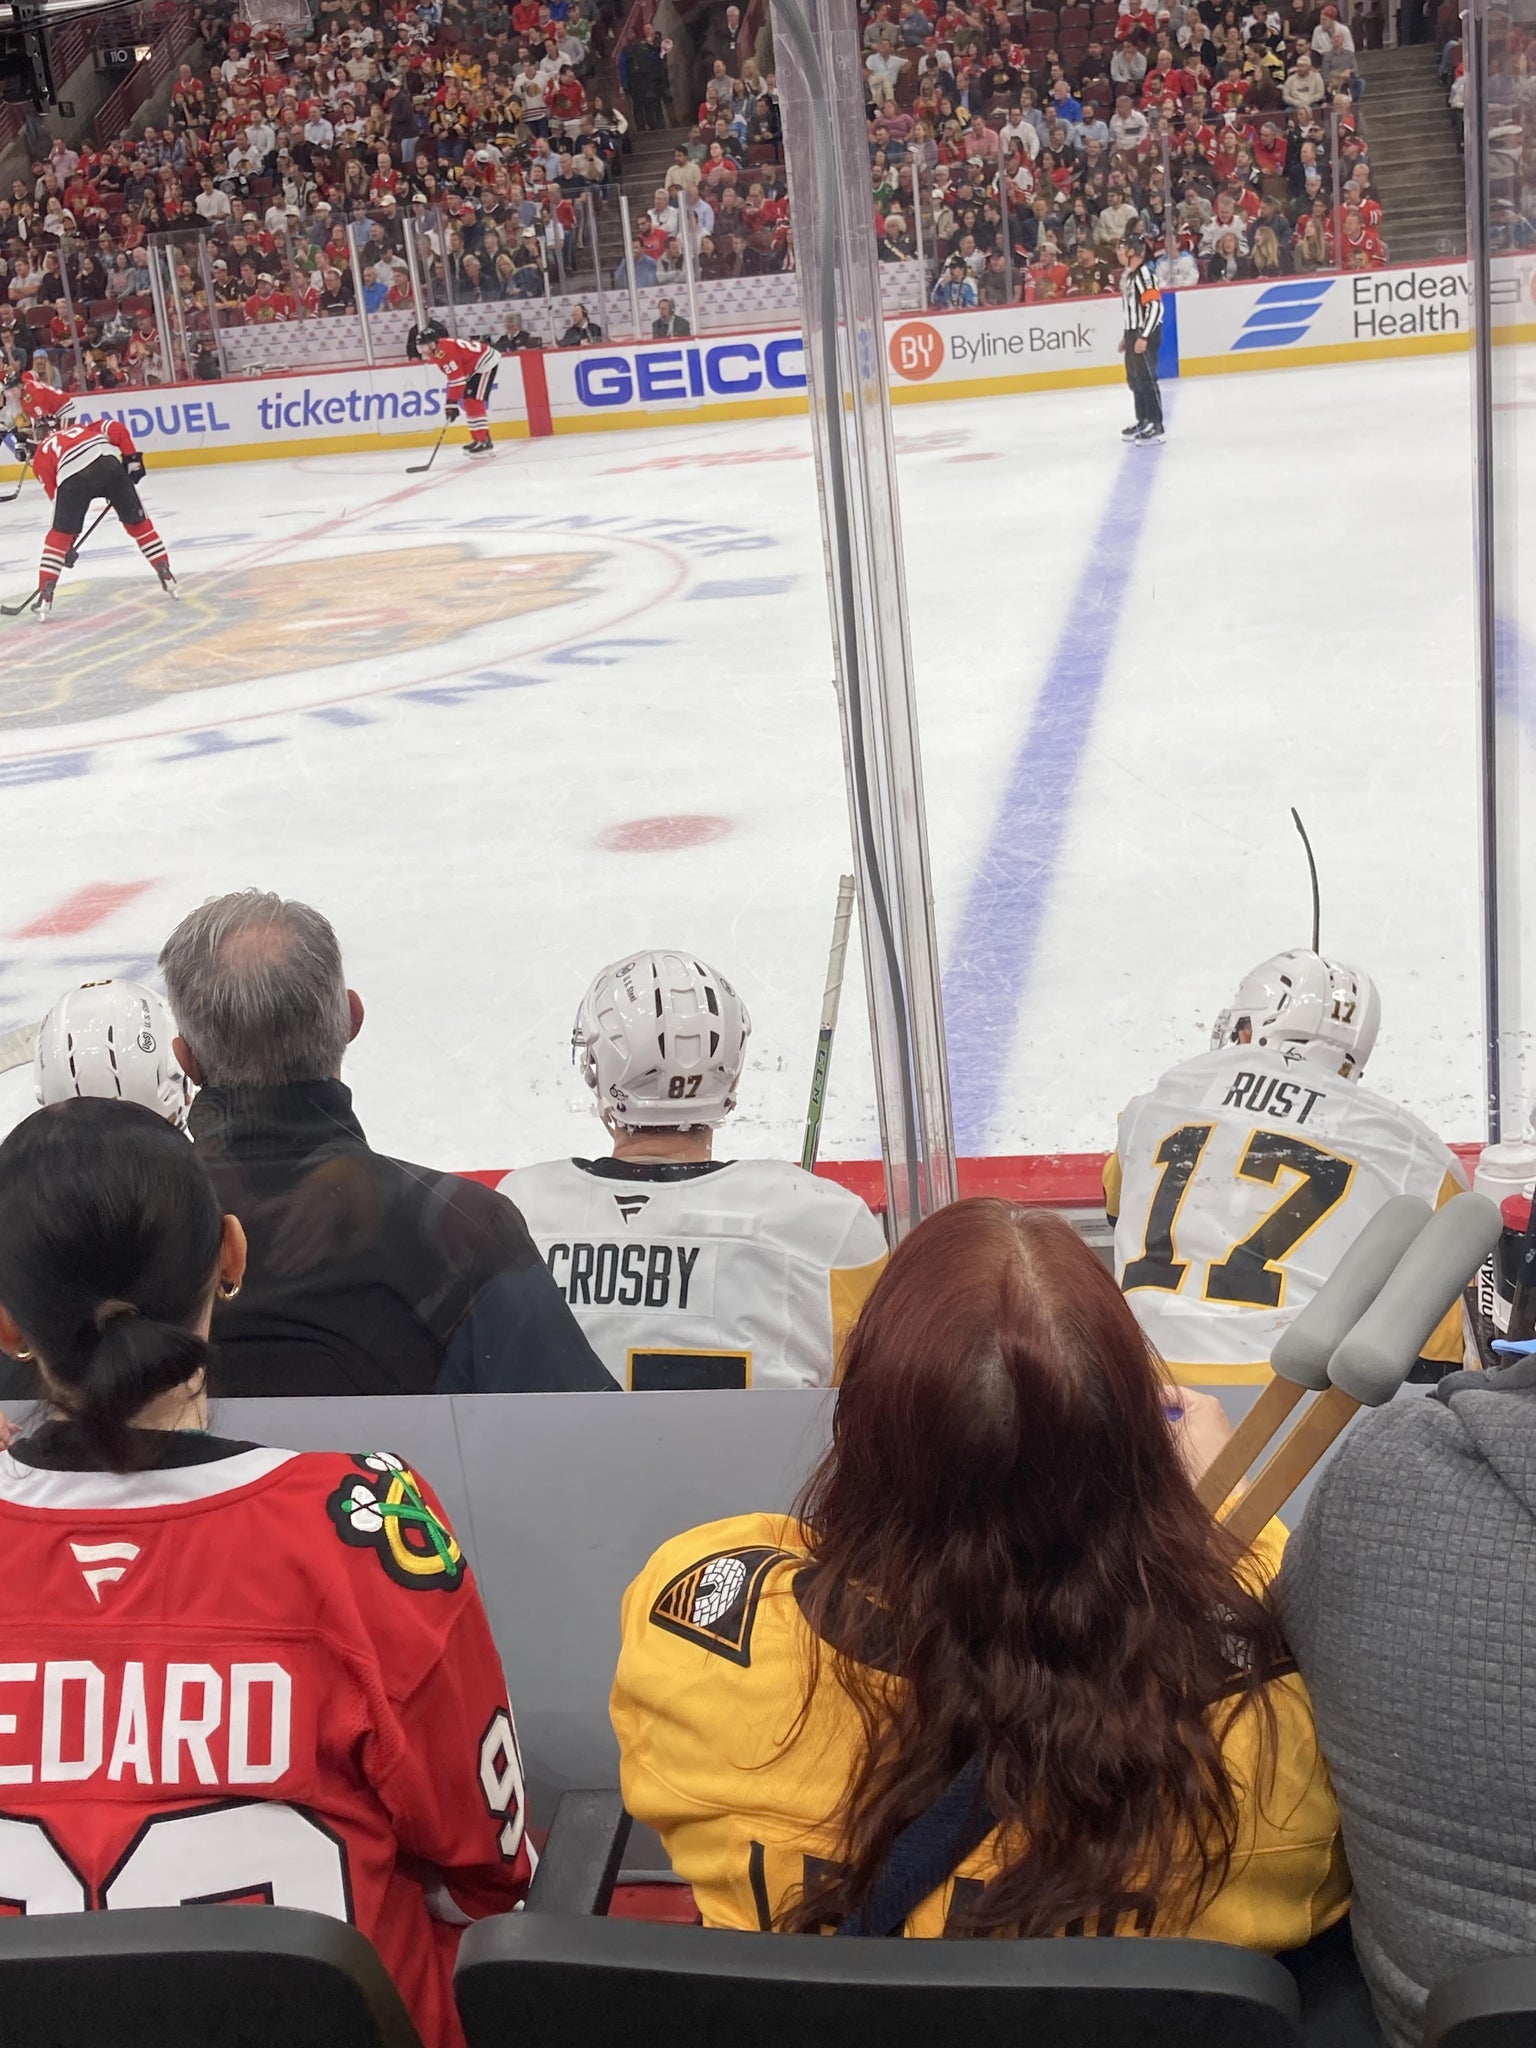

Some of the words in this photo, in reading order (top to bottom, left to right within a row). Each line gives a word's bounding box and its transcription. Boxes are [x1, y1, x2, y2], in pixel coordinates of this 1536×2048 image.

[111, 50, 127, 62] 110
[1354, 302, 1459, 339] Health
[900, 333, 933, 369] BY
[951, 332, 1024, 364] Byline
[1029, 323, 1092, 352] Bank
[257, 383, 498, 430] ticketmas
[1331, 1000, 1356, 1023] 17
[668, 1075, 703, 1099] 87
[1221, 1072, 1326, 1124] RUST
[1121, 1122, 1358, 1308] 17
[547, 1243, 700, 1309] CROSBY
[477, 1707, 526, 1859] 9
